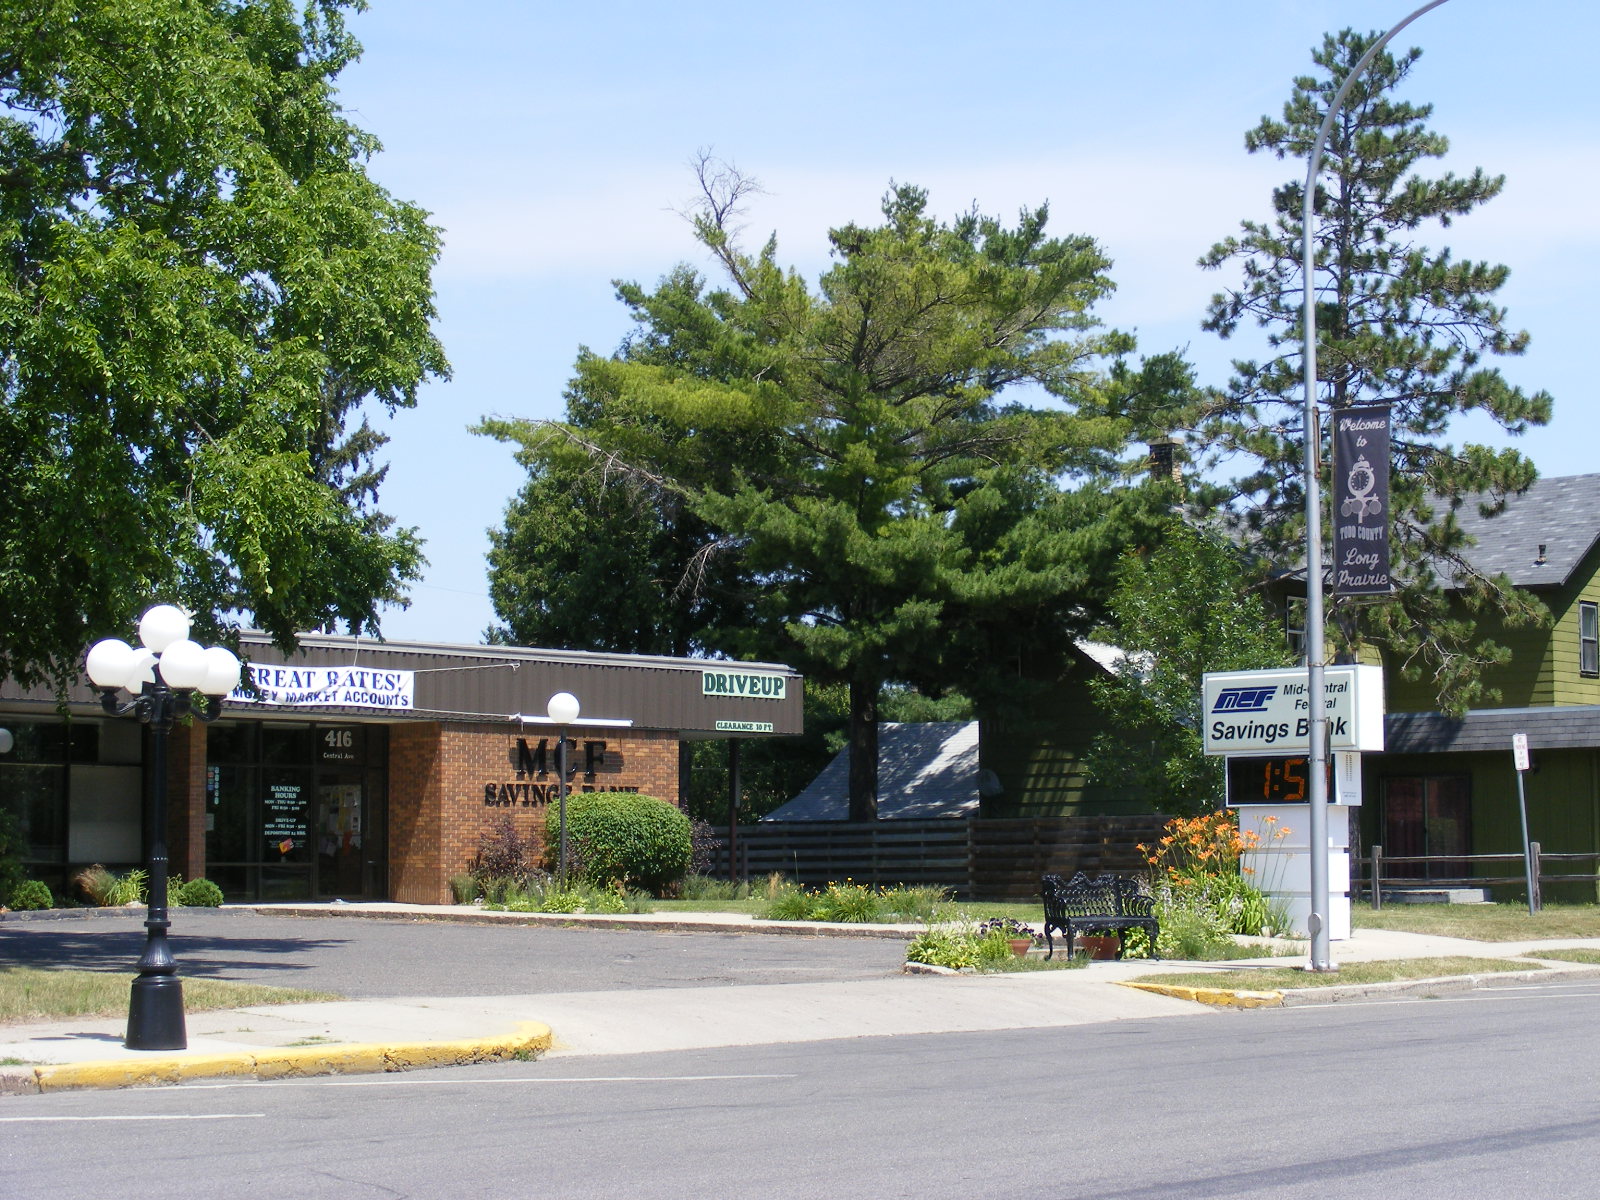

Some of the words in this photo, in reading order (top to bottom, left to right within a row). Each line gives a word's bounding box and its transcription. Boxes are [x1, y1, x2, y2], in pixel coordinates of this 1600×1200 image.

[1339, 417, 1386, 431] Welcome
[1356, 435, 1368, 448] to
[1340, 525, 1356, 540] TODD
[1357, 525, 1384, 541] COUNTY
[1343, 547, 1379, 570] Long
[1337, 569, 1388, 587] Prairie
[327, 670, 402, 692] RATES!
[704, 672, 784, 696] DRIVEUP
[1283, 681, 1348, 696] Mid-ntral
[232, 687, 278, 702] MOEY
[285, 690, 338, 703] MARKET
[344, 691, 408, 706] ACCOUNTS
[716, 722, 753, 730] CLEARANCE
[1211, 720, 1289, 744] Savings
[1295, 717, 1348, 737] Bk
[325, 730, 353, 747] 416
[516, 738, 607, 778] MCF
[1263, 758, 1332, 800] 1:5
